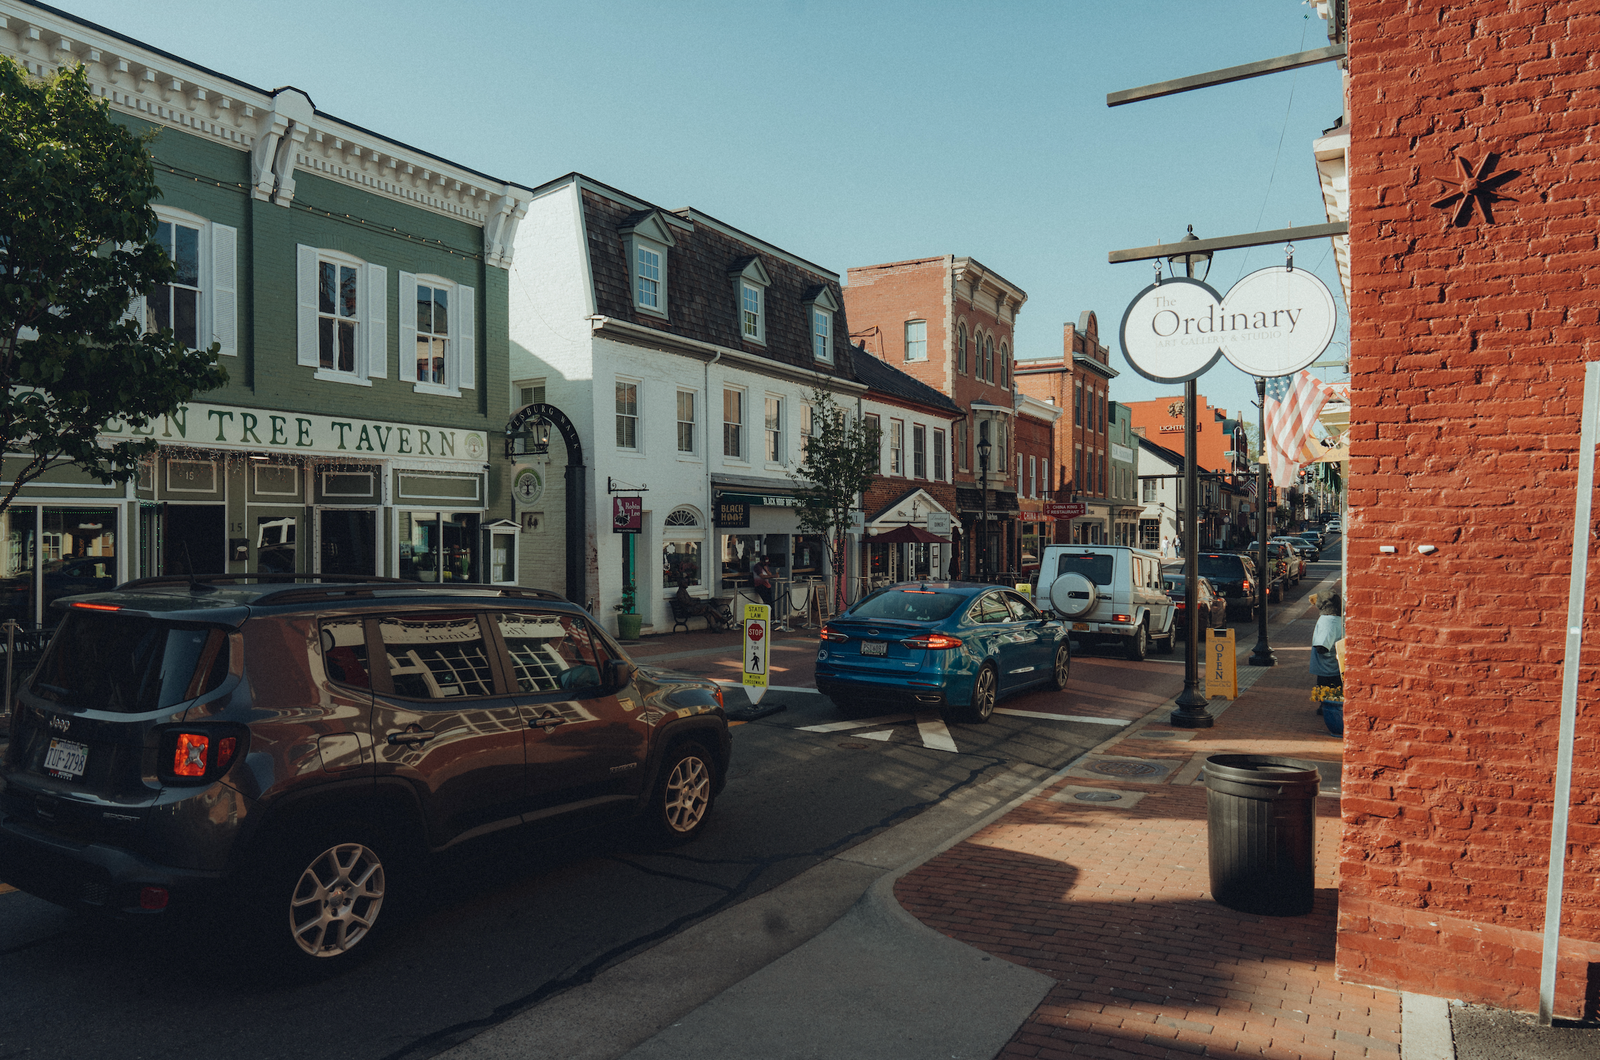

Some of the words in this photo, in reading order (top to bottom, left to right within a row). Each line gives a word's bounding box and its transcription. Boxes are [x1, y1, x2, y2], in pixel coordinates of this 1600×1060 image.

[1153, 296, 1177, 308] The
[1151, 304, 1303, 337] Ordinary
[1241, 330, 1282, 342] STUDIO
[208, 409, 313, 447] TREE
[331, 421, 456, 457] TAVERN
[559, 415, 580, 450] WALK
[185, 470, 195, 481] 15
[625, 501, 640, 510] Robin
[721, 504, 744, 513] BLACK
[631, 509, 640, 517] Lee
[721, 512, 744, 522] HOOF
[230, 522, 243, 532] 15
[748, 628, 763, 636] STOP
[1215, 643, 1225, 679] OPEN
[49, 715, 71, 733] Jeep
